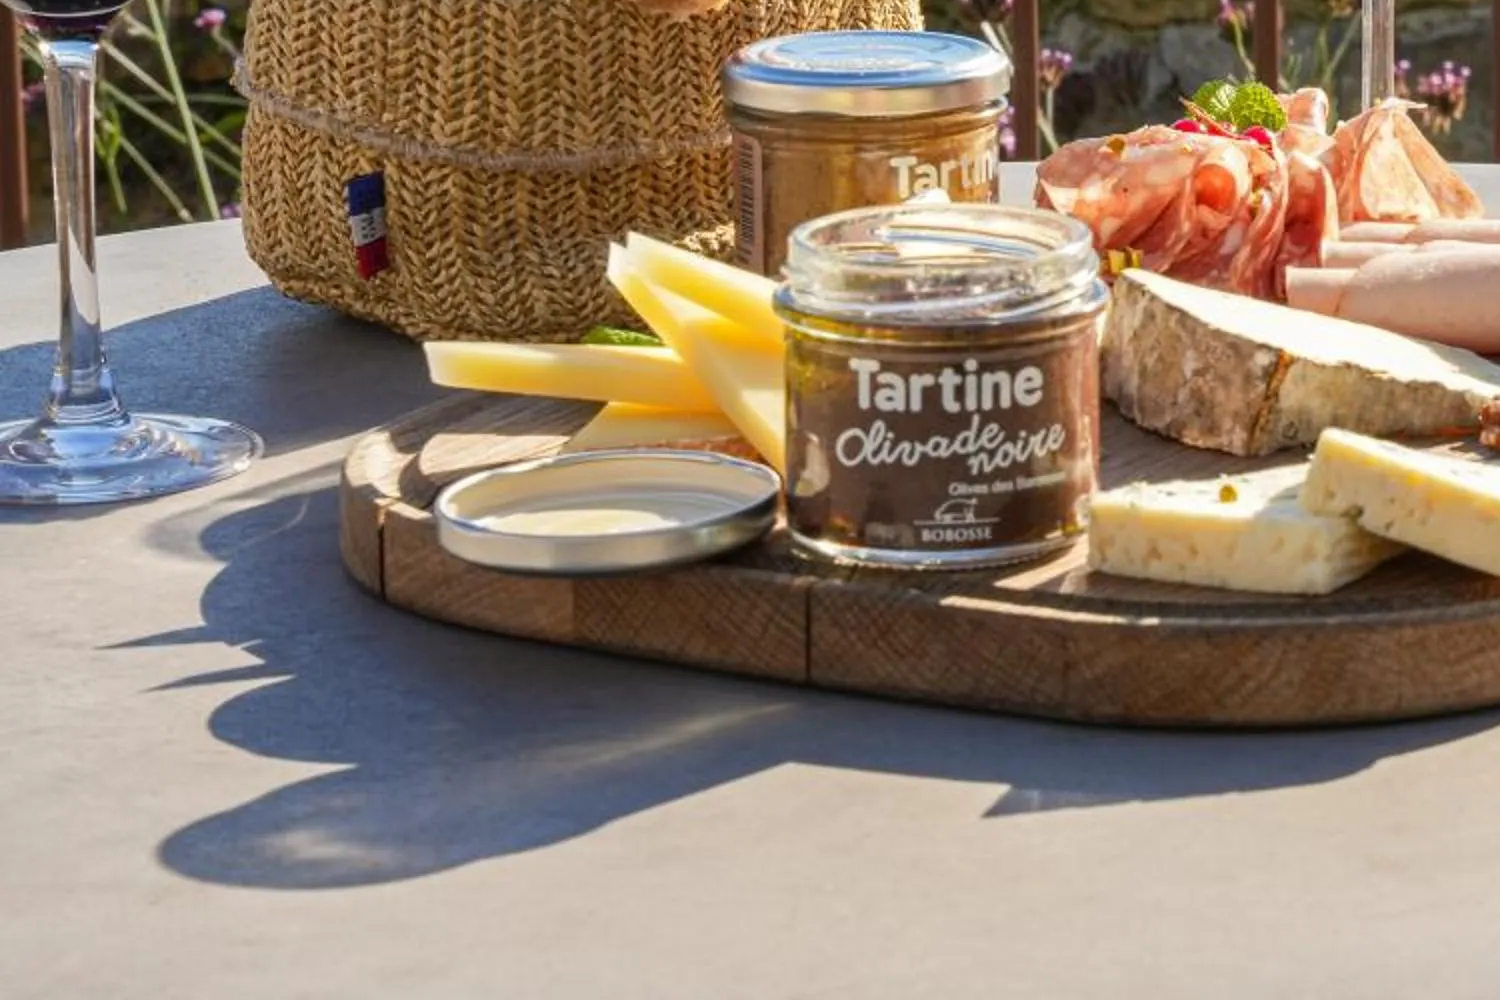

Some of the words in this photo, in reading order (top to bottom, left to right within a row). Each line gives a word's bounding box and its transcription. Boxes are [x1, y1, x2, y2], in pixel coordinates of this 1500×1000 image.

[848, 357, 1044, 413] Tartine
[835, 413, 1004, 467] Olivade
[921, 527, 992, 542] BOBOSSE
